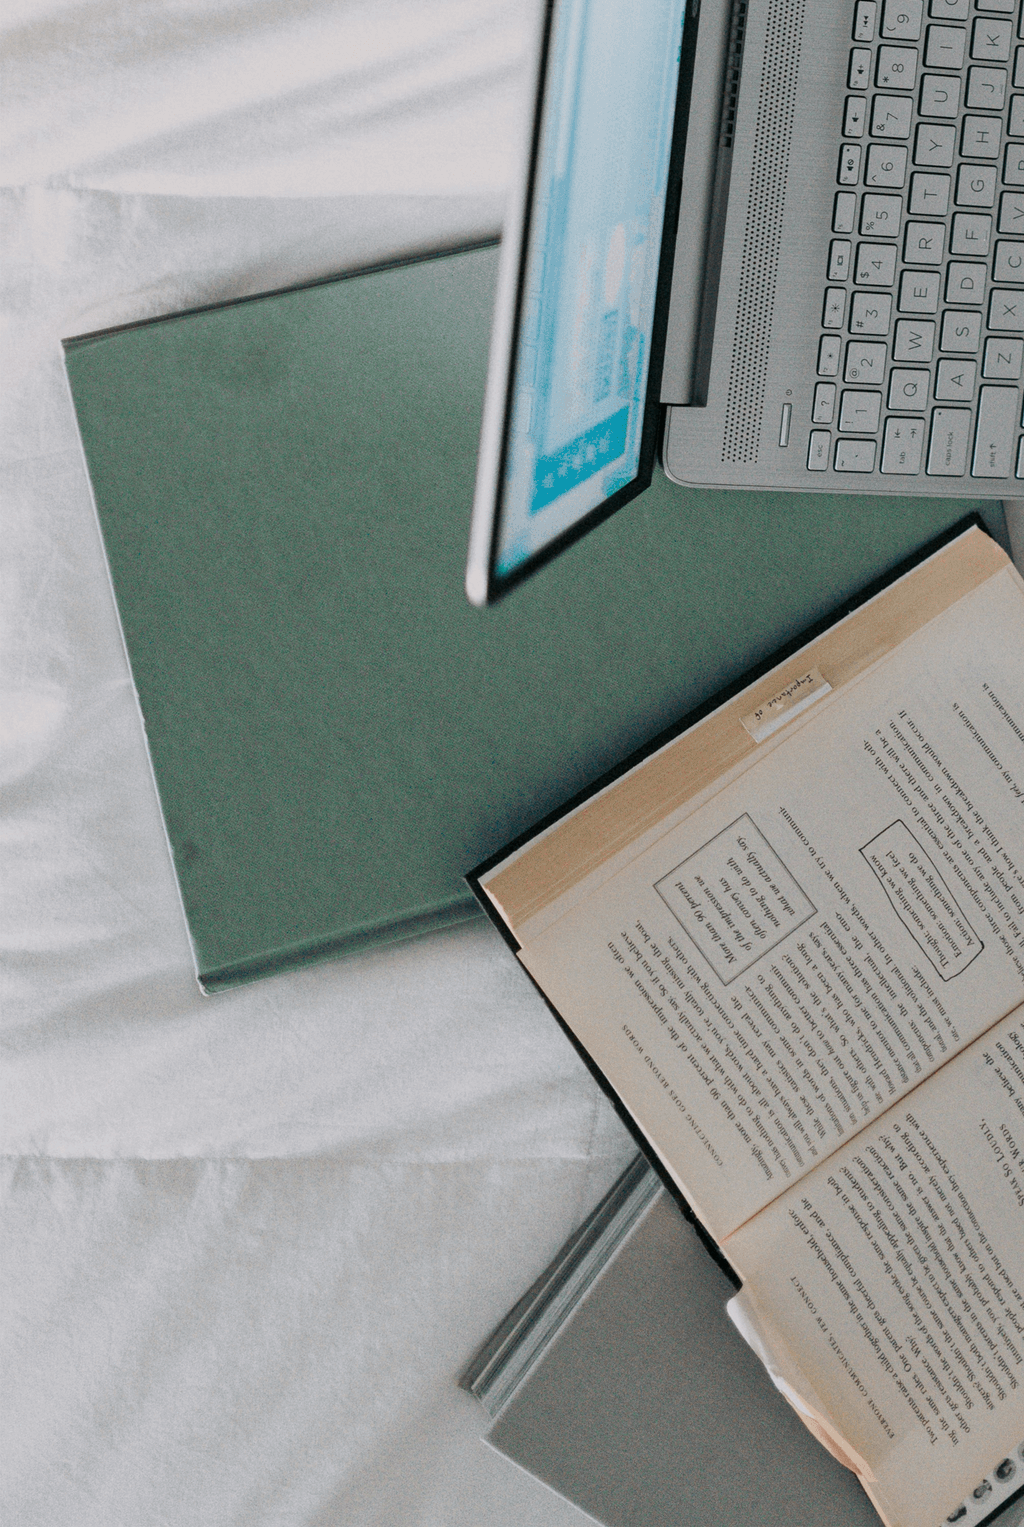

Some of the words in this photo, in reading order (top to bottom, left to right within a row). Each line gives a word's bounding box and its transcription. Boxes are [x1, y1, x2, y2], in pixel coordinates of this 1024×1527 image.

[985, 33, 1000, 47] K
[933, 89, 948, 103] U
[980, 82, 995, 93] J
[928, 138, 943, 152] Y
[975, 129, 989, 144] H
[923, 188, 938, 200] T
[969, 178, 985, 193] G
[917, 236, 933, 250] R
[964, 228, 979, 241] F
[1007, 254, 1022, 269] C
[959, 275, 975, 290] D
[912, 286, 928, 298] E
[1001, 303, 1017, 316] X
[954, 325, 970, 337] S
[907, 330, 923, 351] W
[996, 351, 1012, 364] Z
[949, 372, 964, 387] A
[902, 381, 918, 398] Q
[945, 430, 954, 447] lock
[815, 444, 823, 458] esc
[897, 450, 906, 464] tab
[944, 447, 952, 466] caps
[988, 450, 996, 468] shift
[764, 672, 814, 708] Importance
[753, 708, 764, 721] of
[735, 834, 750, 852] say.
[725, 855, 744, 876] with
[744, 849, 773, 884] actually
[869, 853, 889, 878] know
[693, 874, 706, 887] we
[717, 876, 732, 893] has
[739, 874, 752, 887] do
[768, 882, 781, 896] we
[885, 876, 897, 889] we
[673, 879, 702, 910] percent
[748, 886, 759, 897] to
[701, 885, 737, 930] impression
[728, 890, 753, 920] convey
[754, 893, 782, 929] nothing
[776, 894, 796, 917] what
[892, 885, 926, 932] something
[693, 908, 706, 923] 90
[703, 920, 722, 943] than
[731, 928, 745, 943] the
[748, 917, 768, 940] often
[717, 941, 737, 964] More
[738, 939, 753, 952] of
[922, 929, 950, 969] Thought:
[620, 1023, 644, 1054] WORDS
[642, 1054, 670, 1089] BEYOND
[667, 1088, 686, 1113] GOES
[684, 1112, 724, 1167] CONNECTING
[789, 1275, 818, 1315] CONNECT
[814, 1315, 829, 1333] FEW
[826, 1332, 869, 1397] COMMUNICATES,
[866, 1398, 895, 1439] EVERYONE
